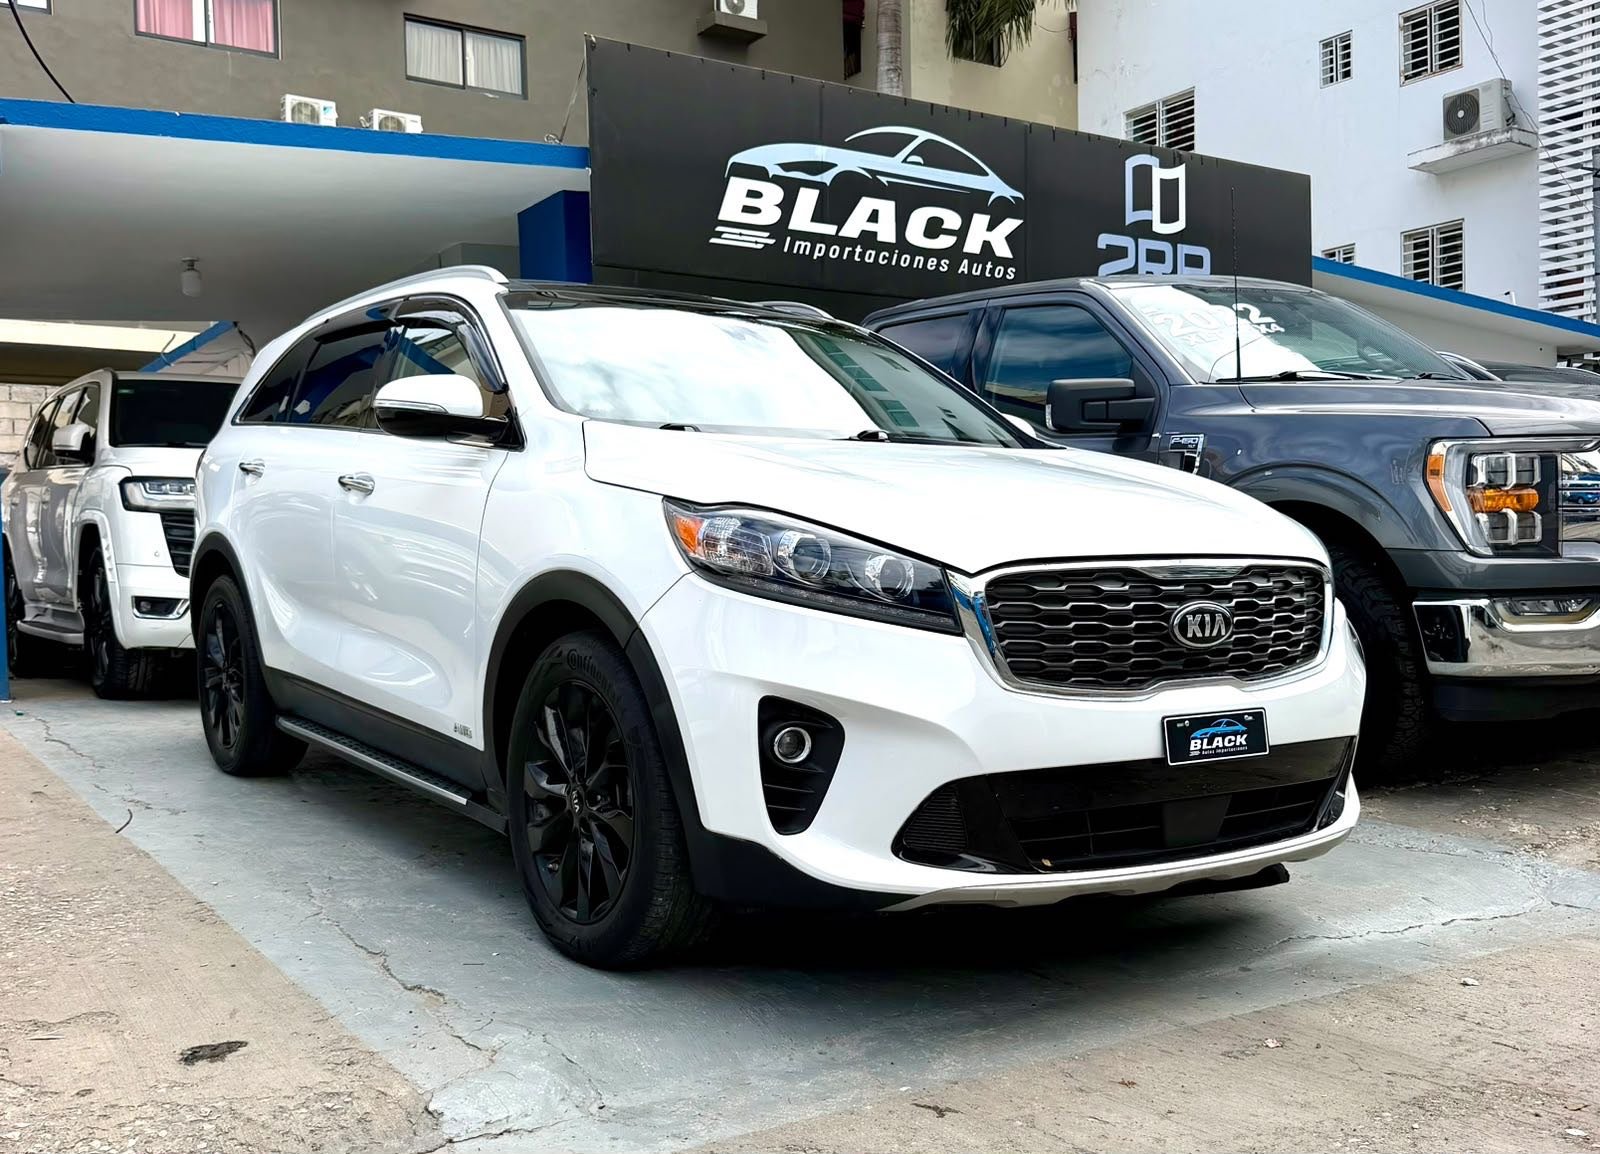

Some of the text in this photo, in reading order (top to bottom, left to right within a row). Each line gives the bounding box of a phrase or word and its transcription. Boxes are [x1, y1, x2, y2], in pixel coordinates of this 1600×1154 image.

[717, 176, 1025, 259] BLACK
[783, 236, 1016, 280] Importaciones Autos
[1153, 303, 1275, 337] 202
[1186, 613, 1226, 638] KIA
[1189, 734, 1248, 751] BLACK
